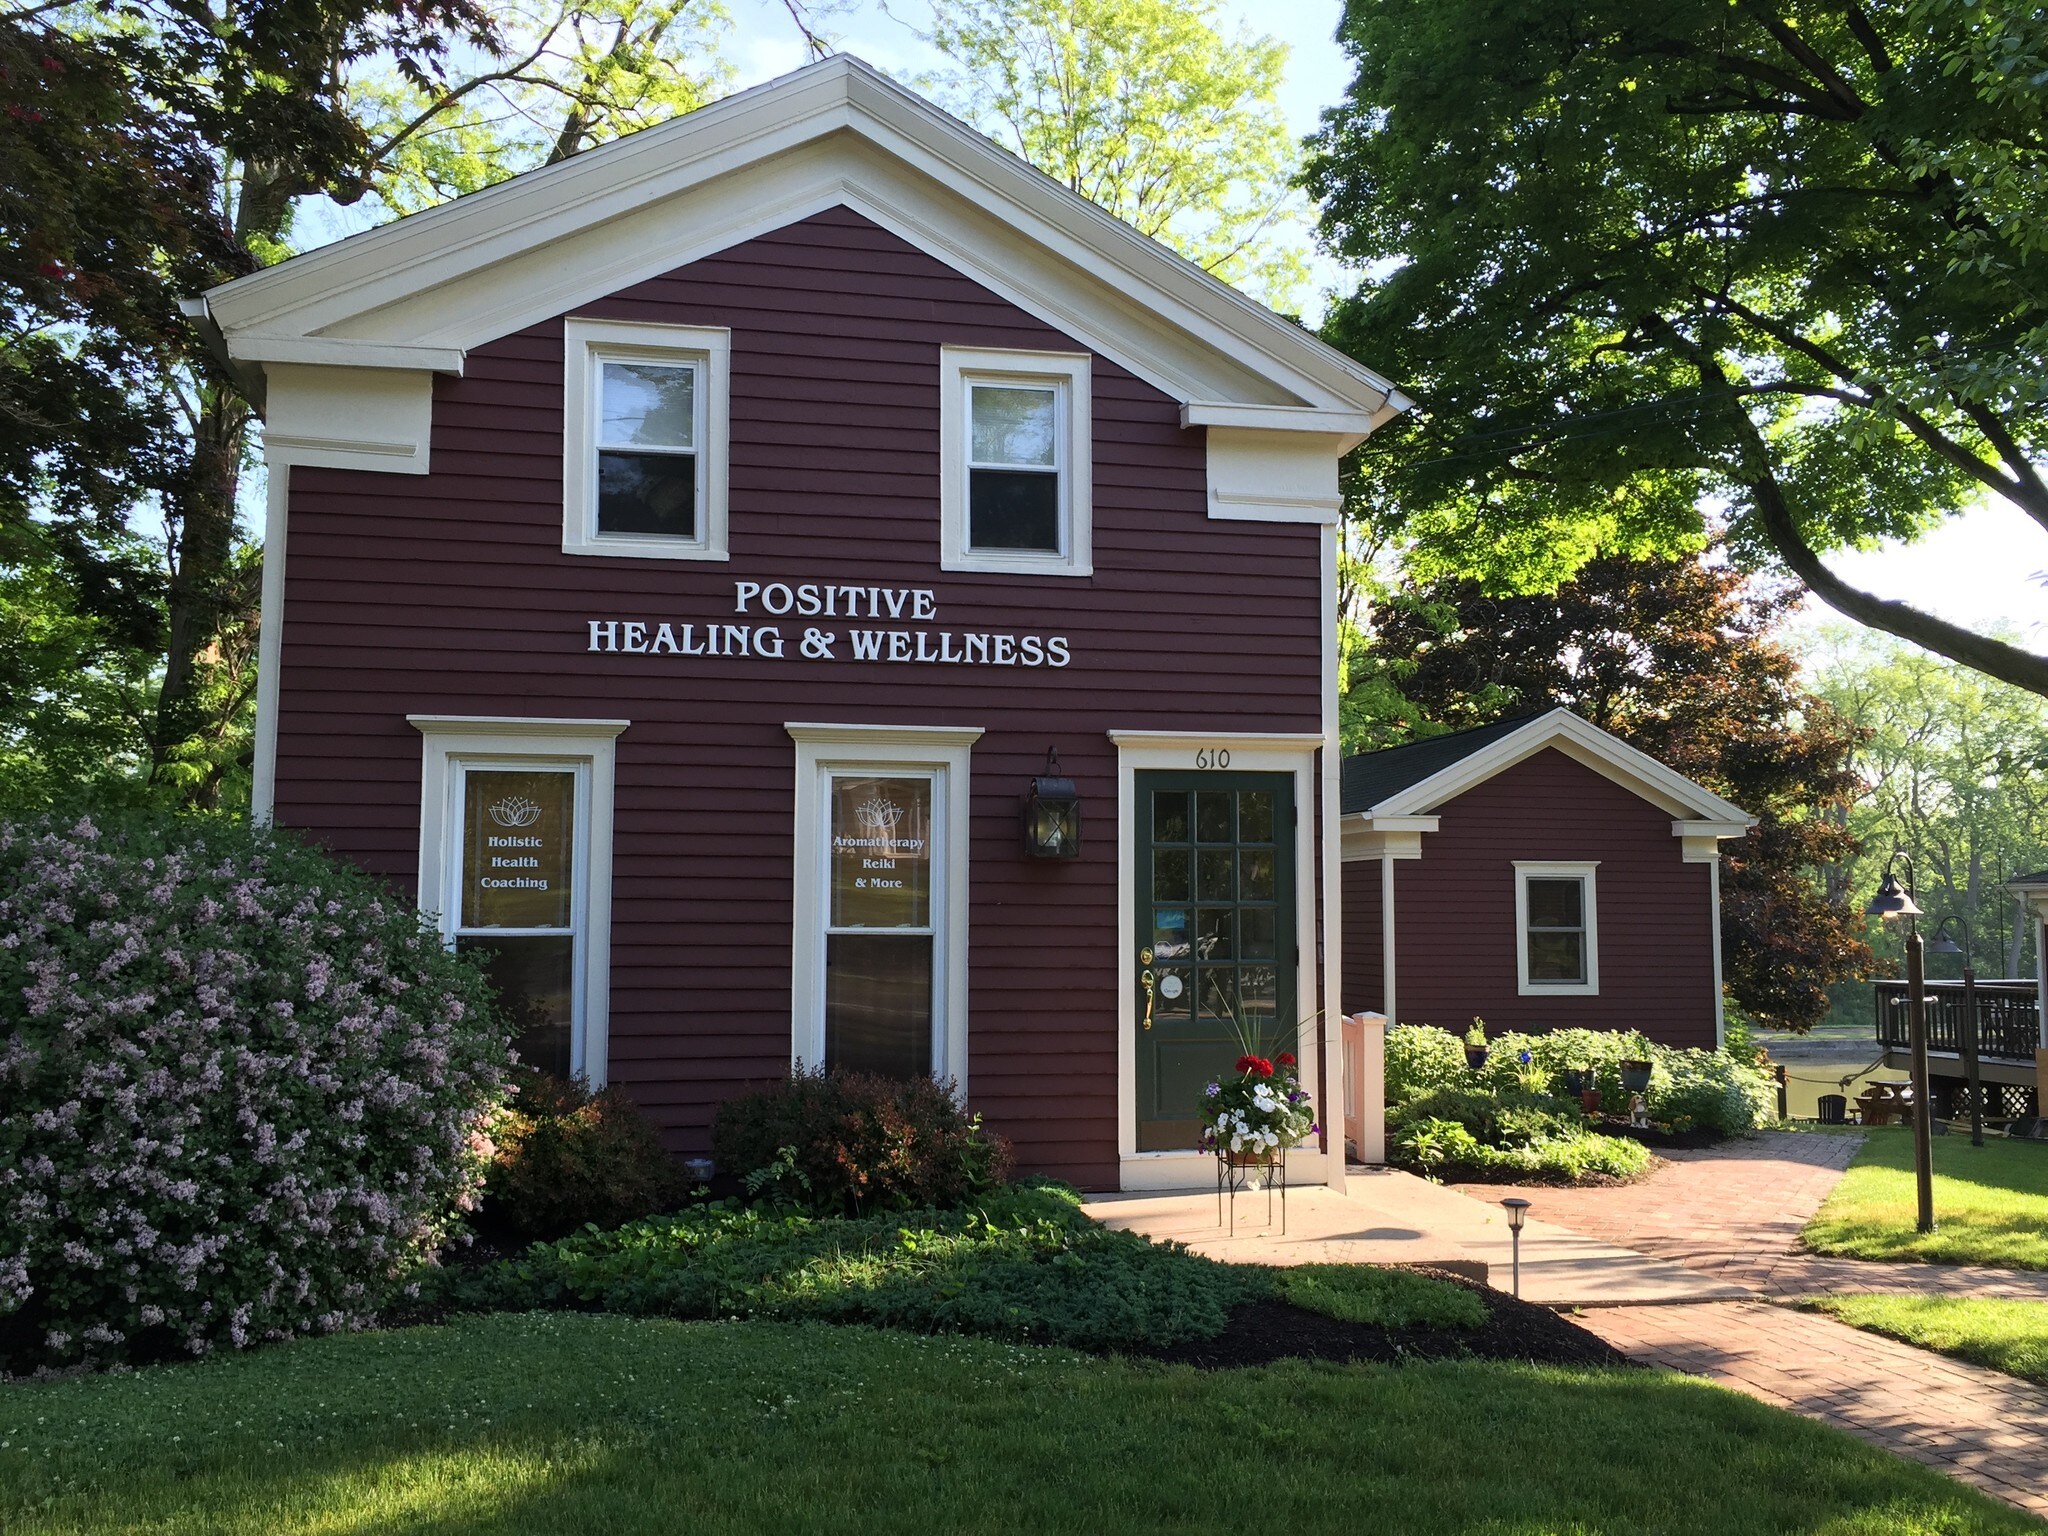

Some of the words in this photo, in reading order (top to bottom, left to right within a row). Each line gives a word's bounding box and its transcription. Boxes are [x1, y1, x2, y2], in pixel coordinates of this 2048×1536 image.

[735, 581, 936, 620] POSITIVE
[587, 620, 785, 658] HEALING
[800, 627, 836, 660] &
[849, 629, 1071, 667] WELLNESS
[1196, 748, 1230, 769] 610
[488, 836, 543, 847] Holistic
[833, 836, 925, 850] Aromatherapy
[491, 856, 539, 868] Health
[862, 858, 896, 869] Reiki
[480, 877, 548, 890] Coaching
[855, 877, 867, 888] &
[870, 878, 903, 888] More
